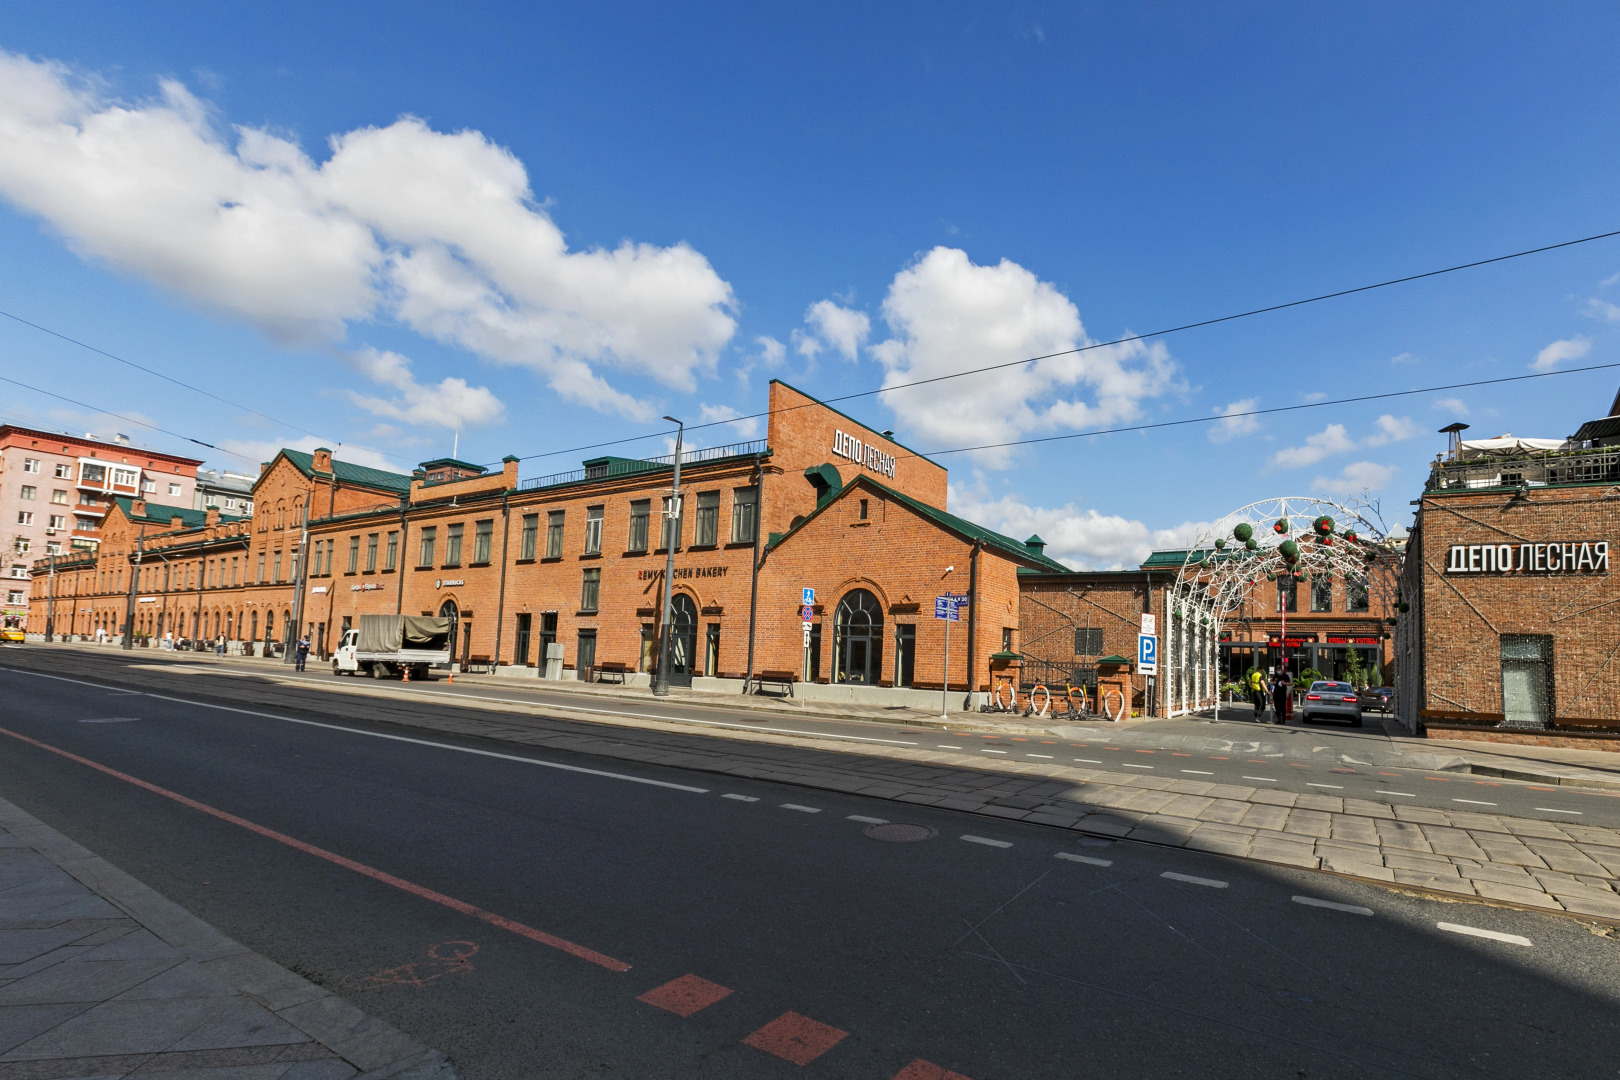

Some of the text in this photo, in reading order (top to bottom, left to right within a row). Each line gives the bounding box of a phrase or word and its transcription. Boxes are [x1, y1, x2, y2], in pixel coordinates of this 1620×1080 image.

[832, 429, 896, 478] ДЕПО ЛЕСНАЯ
[1447, 542, 1609, 572] ДЕПО ЛЕСНАЯ
[659, 567, 693, 579] KCHEN
[695, 566, 729, 578] BAKERY
